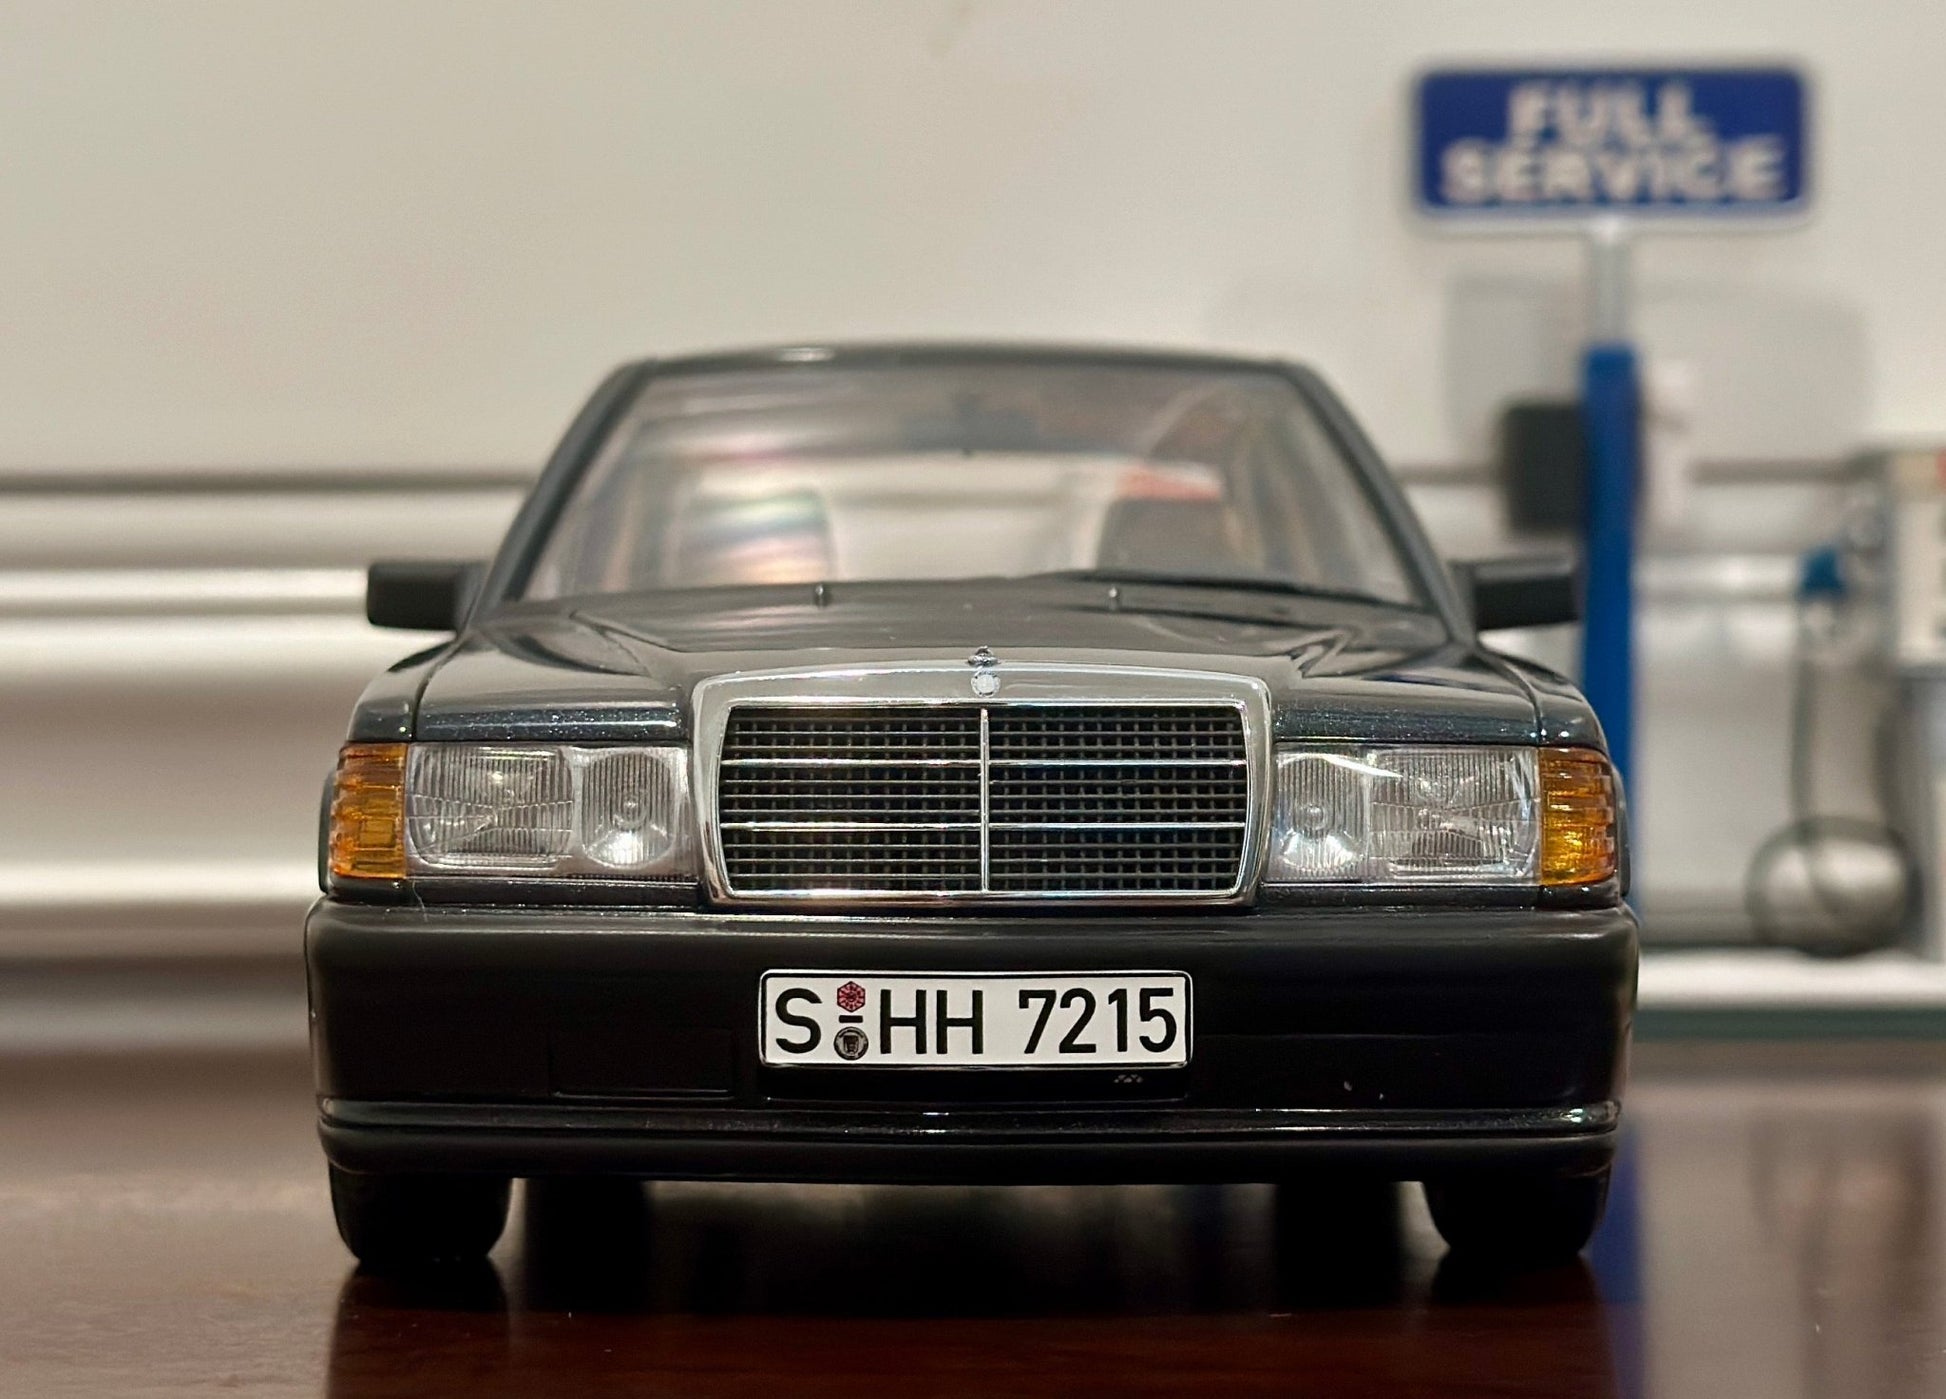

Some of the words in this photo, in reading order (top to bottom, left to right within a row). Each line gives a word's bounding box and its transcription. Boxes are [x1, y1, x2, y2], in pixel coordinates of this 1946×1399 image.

[1508, 82, 1717, 145] FULL
[1440, 137, 1788, 203] SERVICE
[1018, 987, 1177, 1054] 7215
